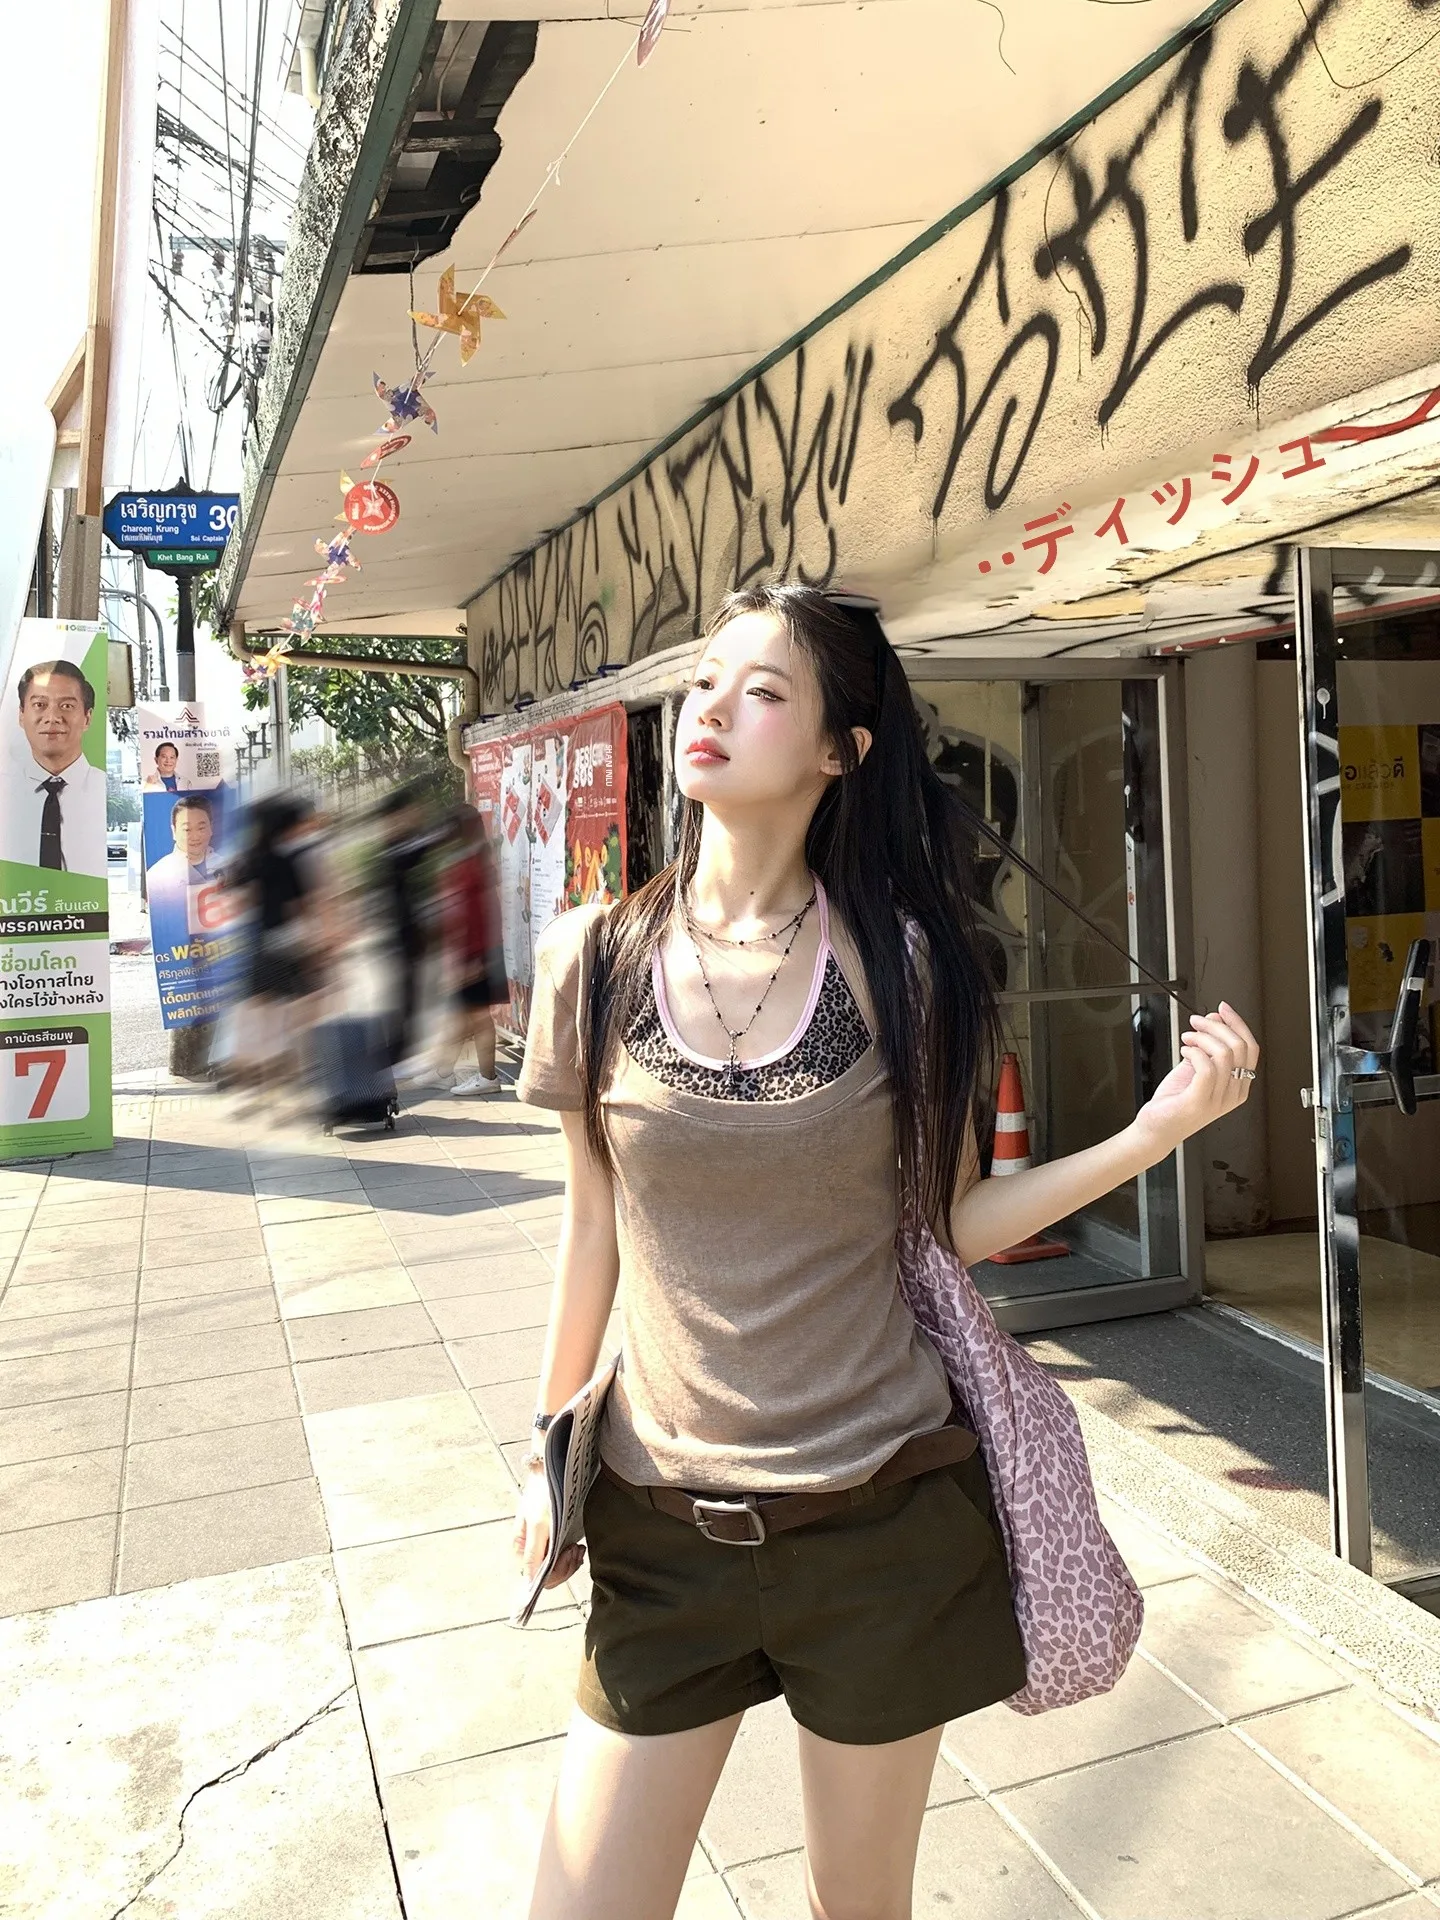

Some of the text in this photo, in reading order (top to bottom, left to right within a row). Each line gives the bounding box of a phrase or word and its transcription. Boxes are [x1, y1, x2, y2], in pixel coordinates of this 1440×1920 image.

[121, 497, 197, 525] เจริญกรุง
[121, 524, 179, 534] Charoen Krung
[202, 535, 224, 544] Captain
[157, 553, 209, 563] Khet Bang Rak
[0, 947, 77, 972] ชื่อมโลก
[4, 1031, 74, 1045] กาบัตรสีชมพู
[15, 1049, 66, 1119] 7
